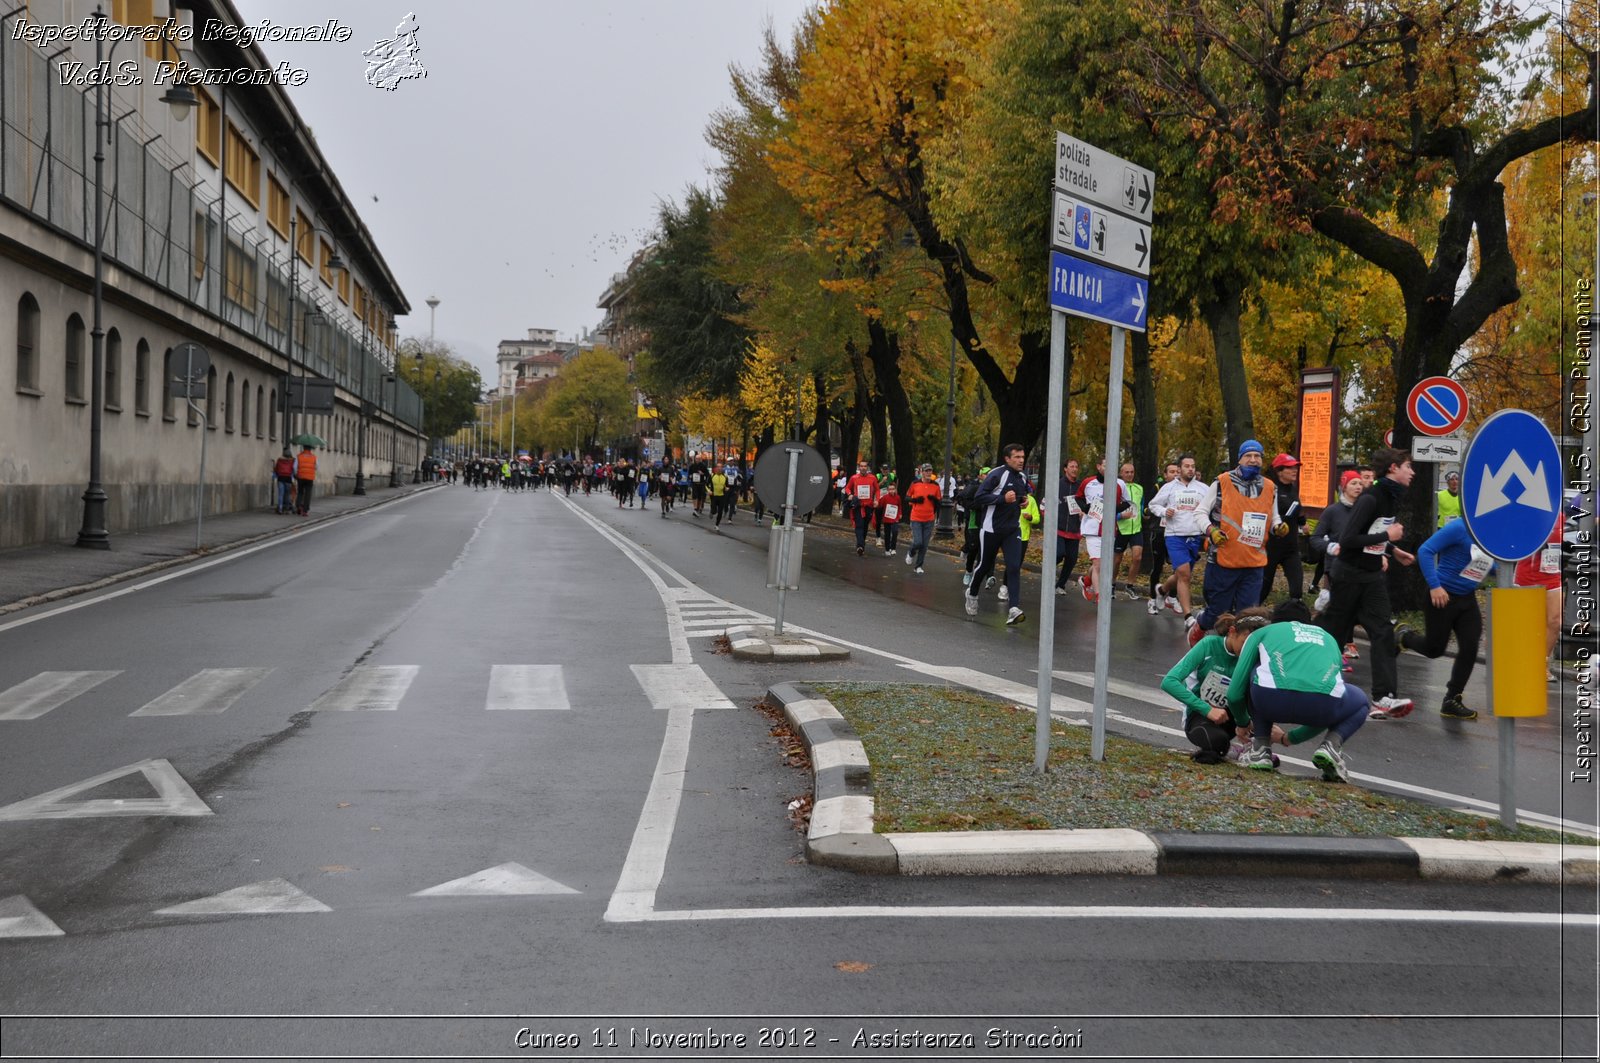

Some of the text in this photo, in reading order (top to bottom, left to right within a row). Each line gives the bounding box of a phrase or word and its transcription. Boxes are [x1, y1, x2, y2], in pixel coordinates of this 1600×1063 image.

[1060, 142, 1091, 168] polizia
[1059, 165, 1098, 193] stradale
[1054, 266, 1103, 304] FRANCIA
